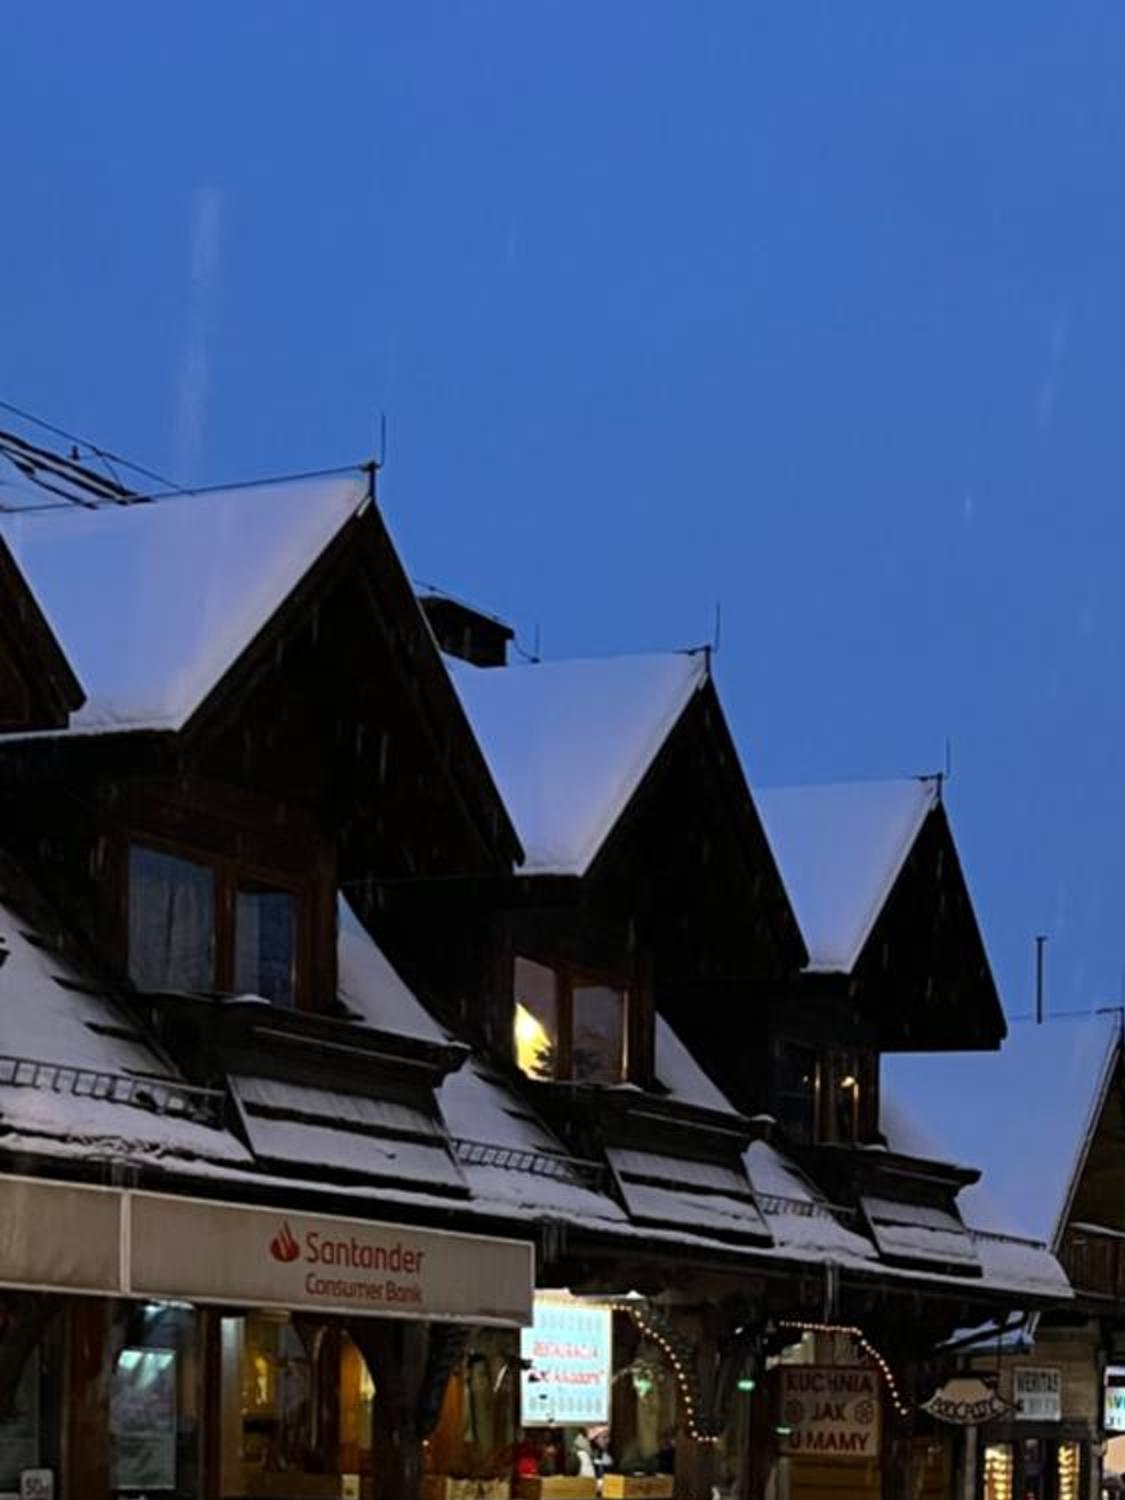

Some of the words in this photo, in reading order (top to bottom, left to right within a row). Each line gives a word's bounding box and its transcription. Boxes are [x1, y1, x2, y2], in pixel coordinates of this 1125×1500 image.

[306, 1232, 424, 1273] Santander
[305, 1273, 384, 1299] Consumer
[385, 1281, 422, 1303] Bank
[787, 1374, 873, 1393] KUCHNIA
[812, 1403, 846, 1422] JAK
[806, 1432, 870, 1451] MAMY
